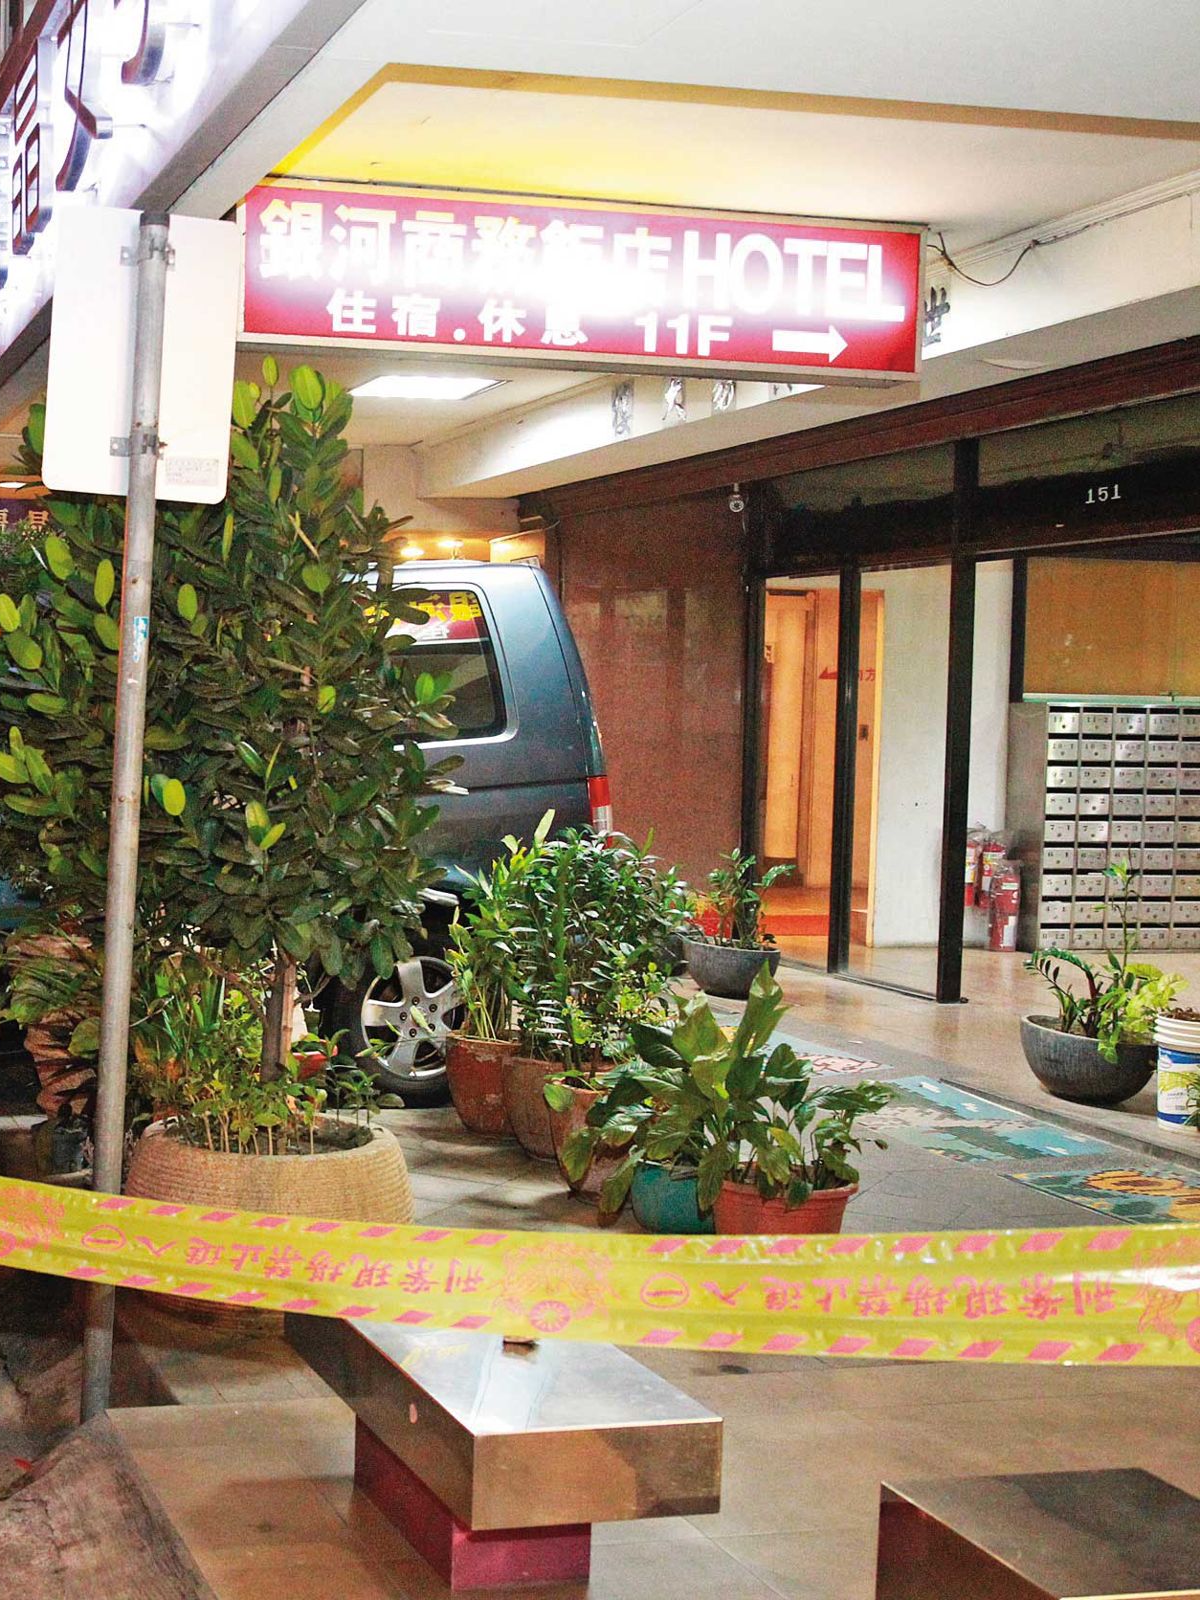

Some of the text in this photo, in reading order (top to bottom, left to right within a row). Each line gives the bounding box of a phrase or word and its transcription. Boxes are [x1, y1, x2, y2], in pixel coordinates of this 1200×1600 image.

[683, 230, 905, 322] HOTEL
[634, 311, 734, 357] 11F
[1085, 484, 1121, 504] 151
[134, 1234, 484, 1294] 刑案現場禁止進入
[701, 1273, 1118, 1321] 刑案現場禁止進入
